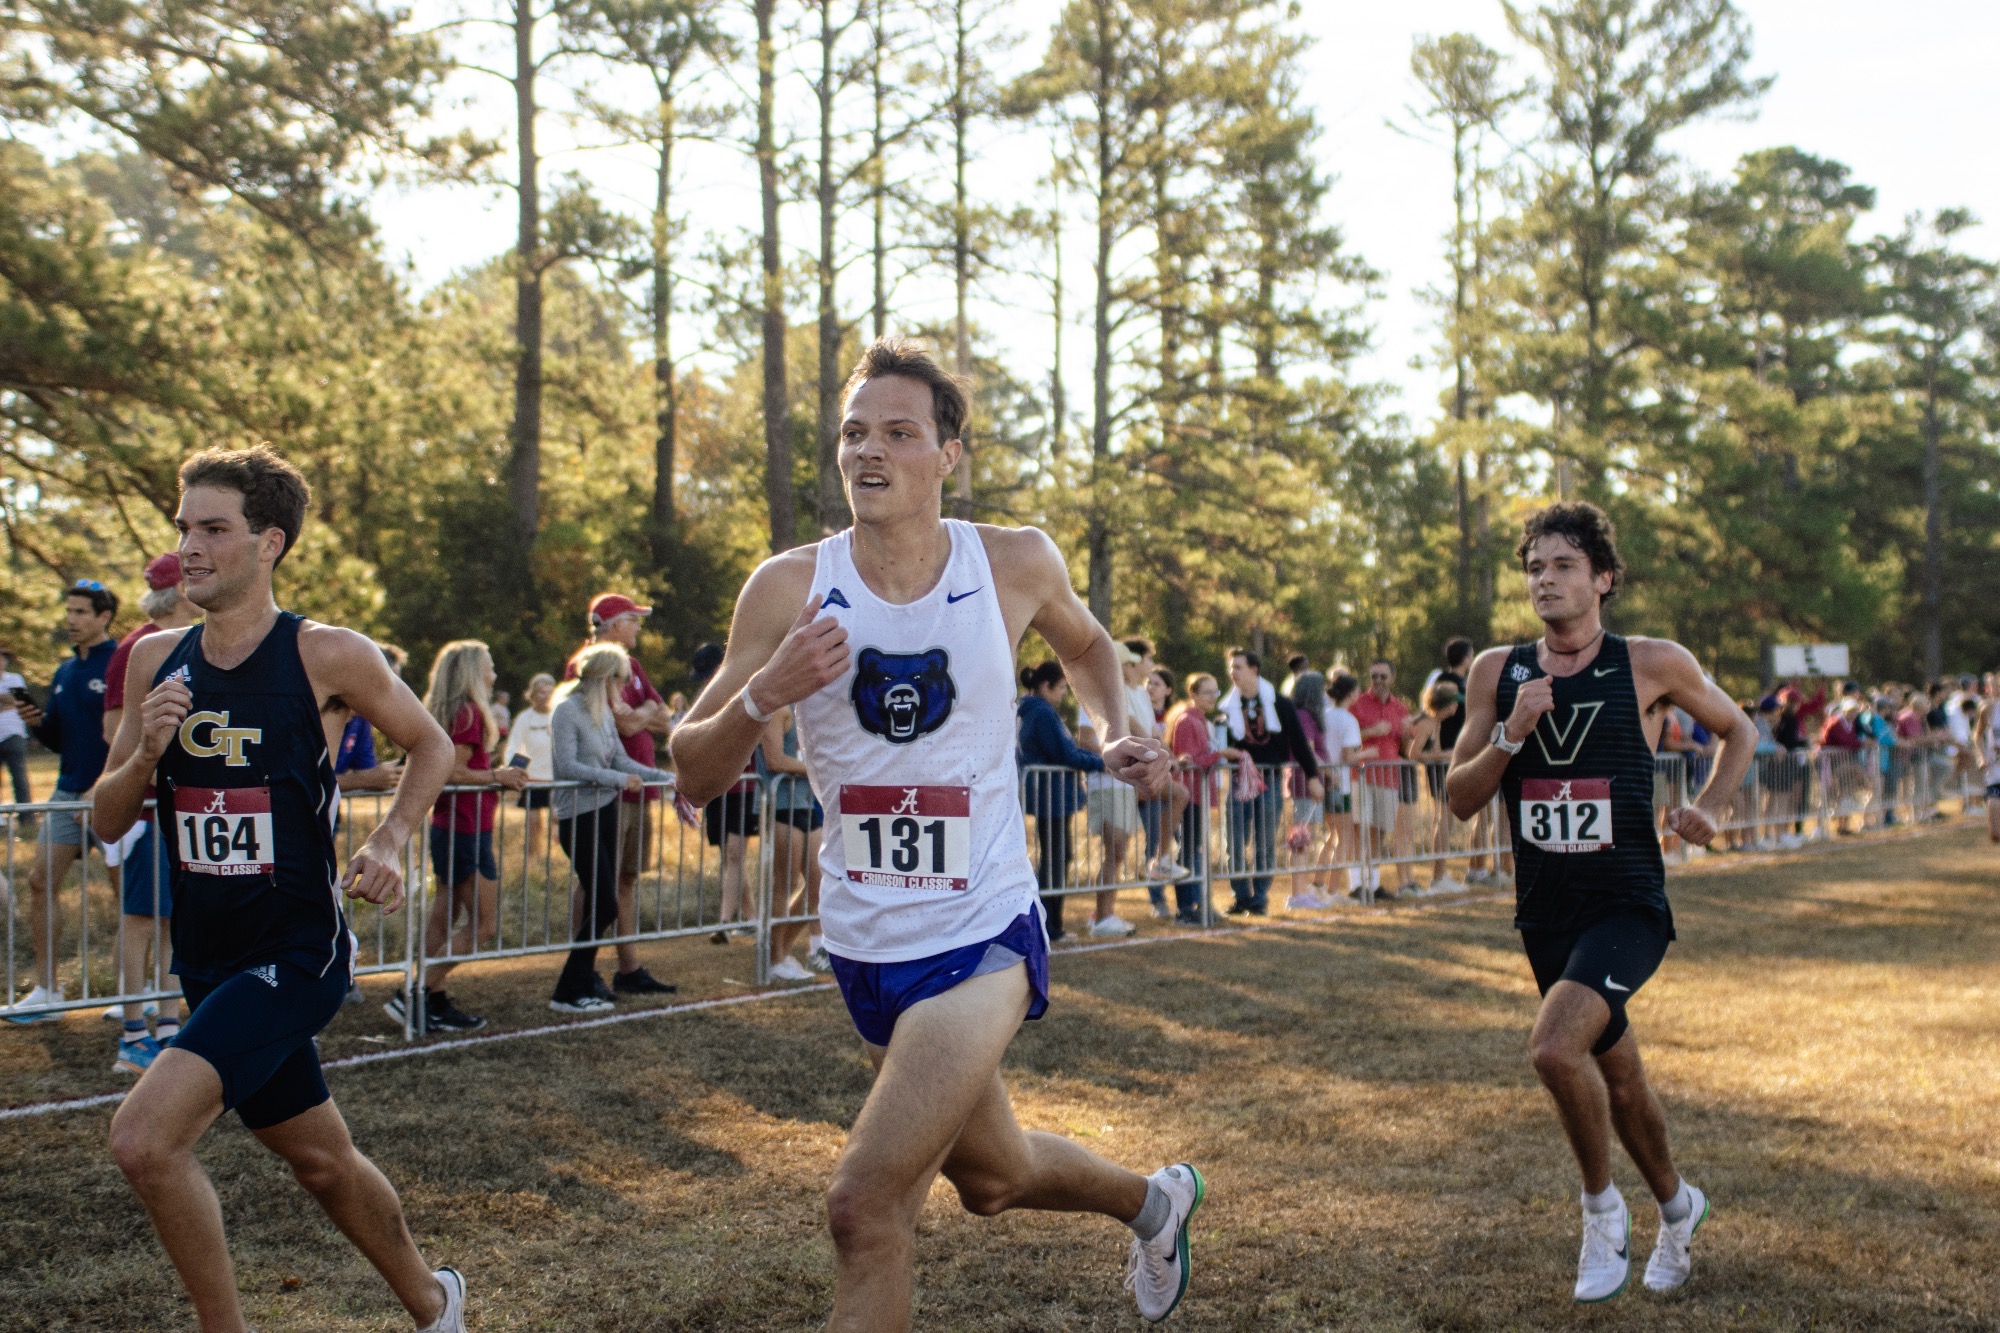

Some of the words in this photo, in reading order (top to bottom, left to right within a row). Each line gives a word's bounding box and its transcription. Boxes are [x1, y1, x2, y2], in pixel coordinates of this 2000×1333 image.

[1512, 663, 1530, 681] SEC
[179, 710, 262, 767] GT
[1533, 701, 1605, 766] V
[204, 790, 227, 814] A
[891, 788, 919, 815] A
[1552, 781, 1573, 801] A
[1530, 802, 1601, 842] 312
[183, 815, 261, 863] 164
[858, 817, 946, 874] 131
[1568, 843, 1602, 854] CLASSIC
[188, 863, 220, 876] CRIMSON
[221, 864, 262, 876] CLASSIC
[861, 872, 906, 888] CRIMSON
[908, 877, 954, 890] CLASSIC
